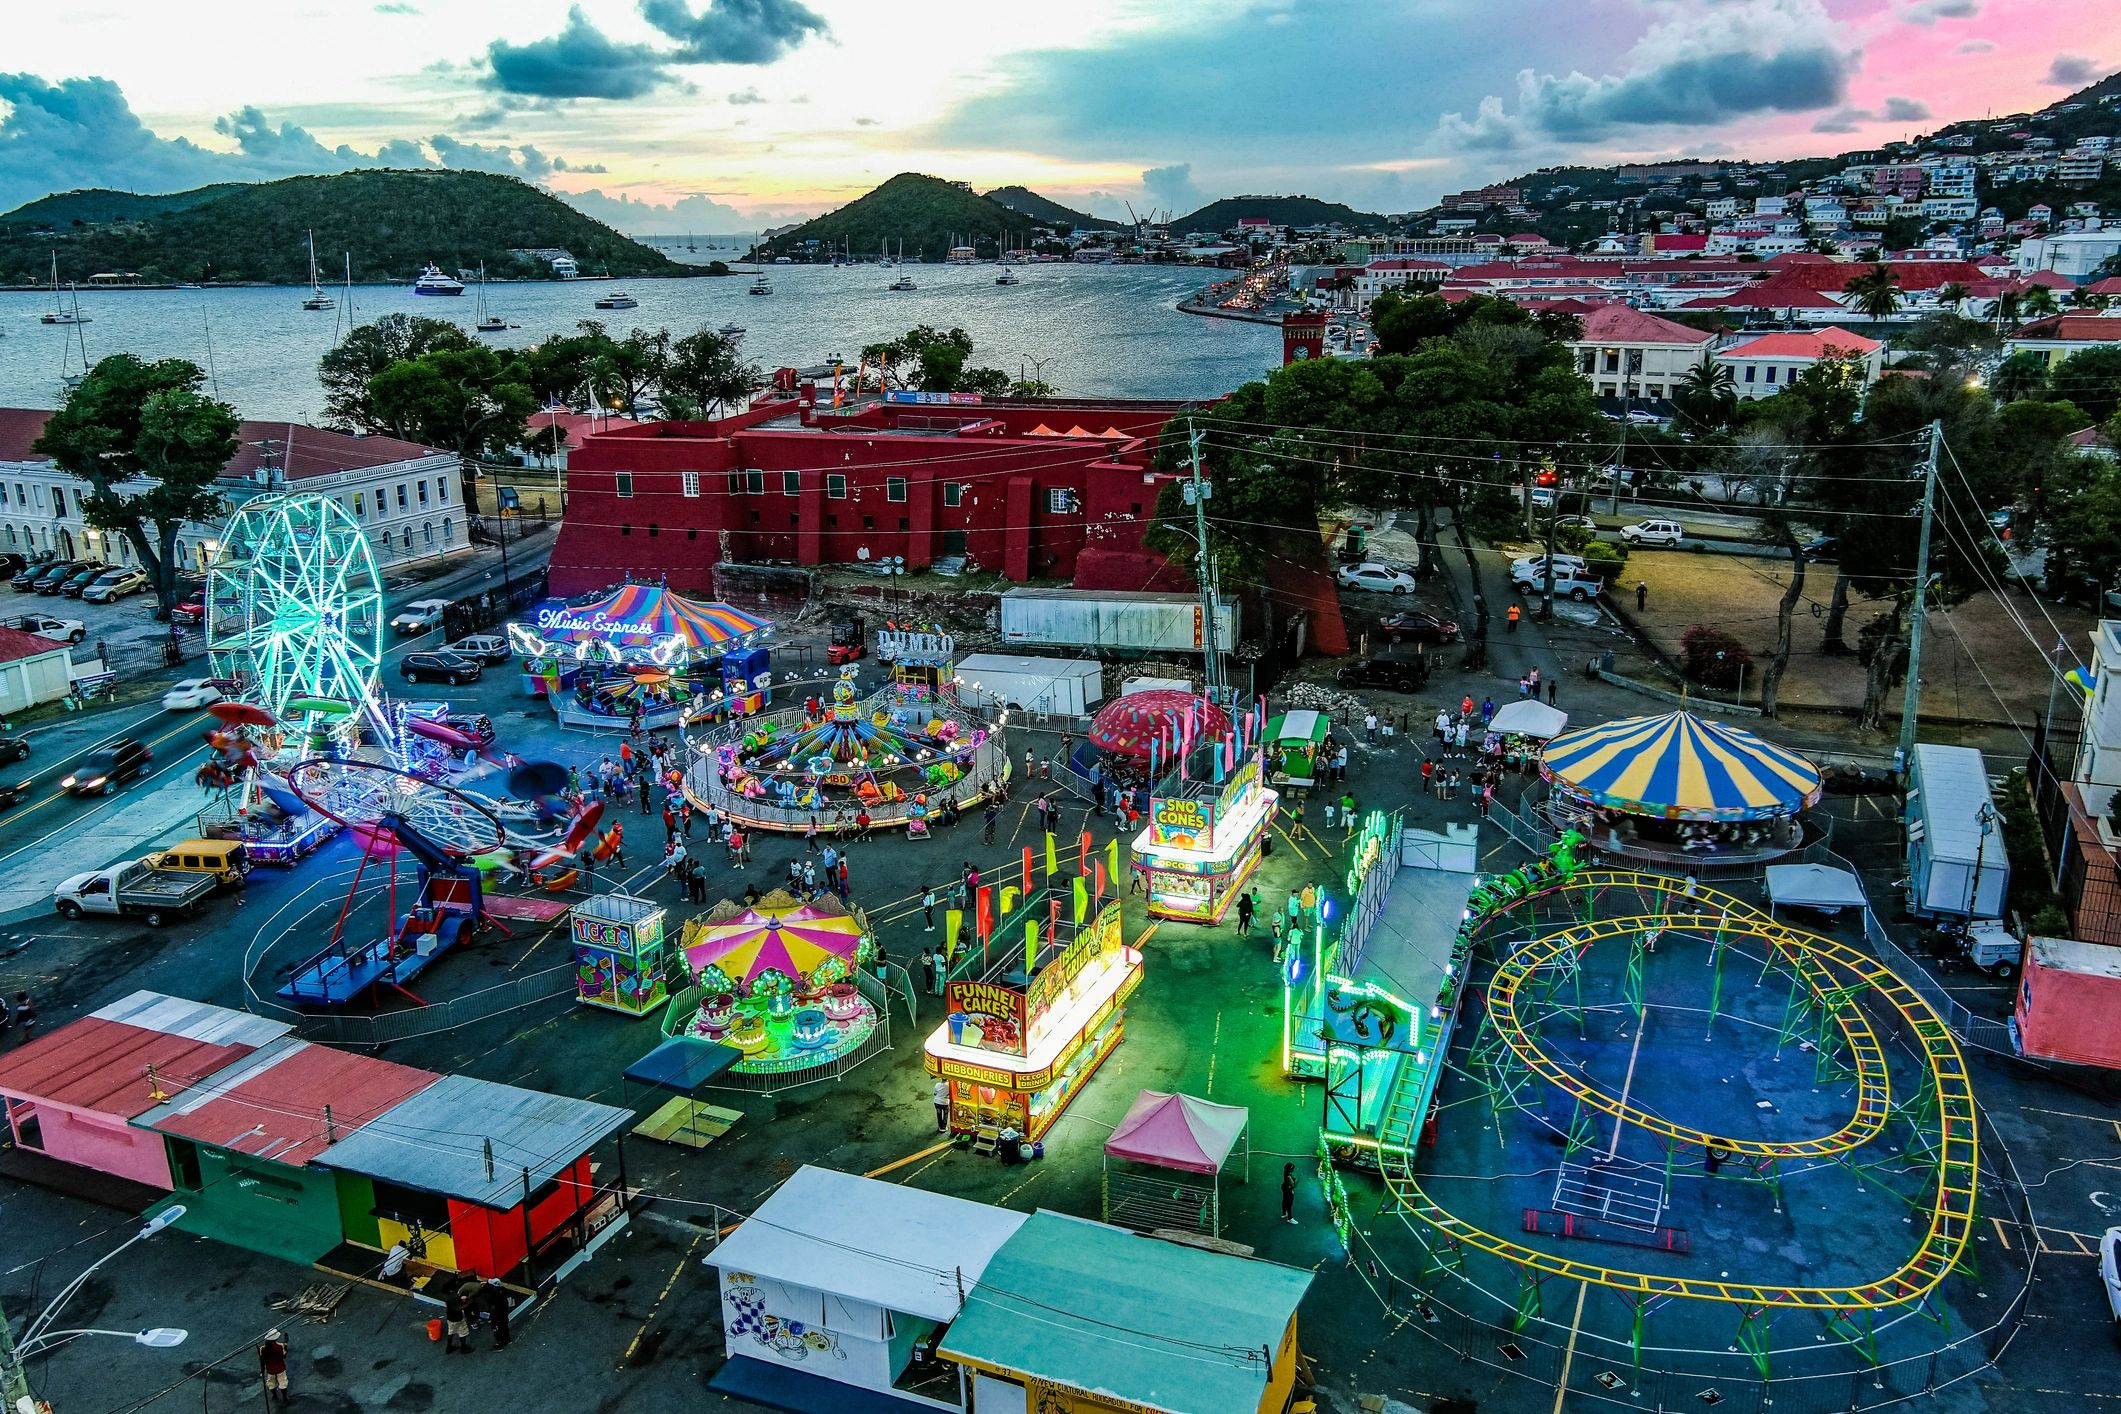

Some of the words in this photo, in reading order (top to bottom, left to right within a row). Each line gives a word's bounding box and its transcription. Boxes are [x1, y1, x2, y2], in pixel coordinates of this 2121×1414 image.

[538, 609, 591, 631] Music
[592, 612, 654, 638] Express
[1194, 608, 1202, 646] XTRA
[877, 629, 955, 656] DUMBO
[1167, 799, 1197, 814] SNO
[1158, 812, 1205, 829] CONES
[1151, 858, 1200, 871] POPCORN
[575, 919, 630, 950] TICKETS
[638, 920, 660, 947] TICKETS
[1060, 926, 1091, 970] ISLAND
[1066, 946, 1090, 983] GRILL
[953, 984, 1017, 1012] FUNNEL
[963, 998, 1010, 1020] CAKES
[944, 1063, 981, 1078] RIBBON
[983, 1070, 1009, 1084] FRIES
[1031, 1071, 1049, 1080] COLD
[1057, 1382, 1089, 1398] CULTURAL
